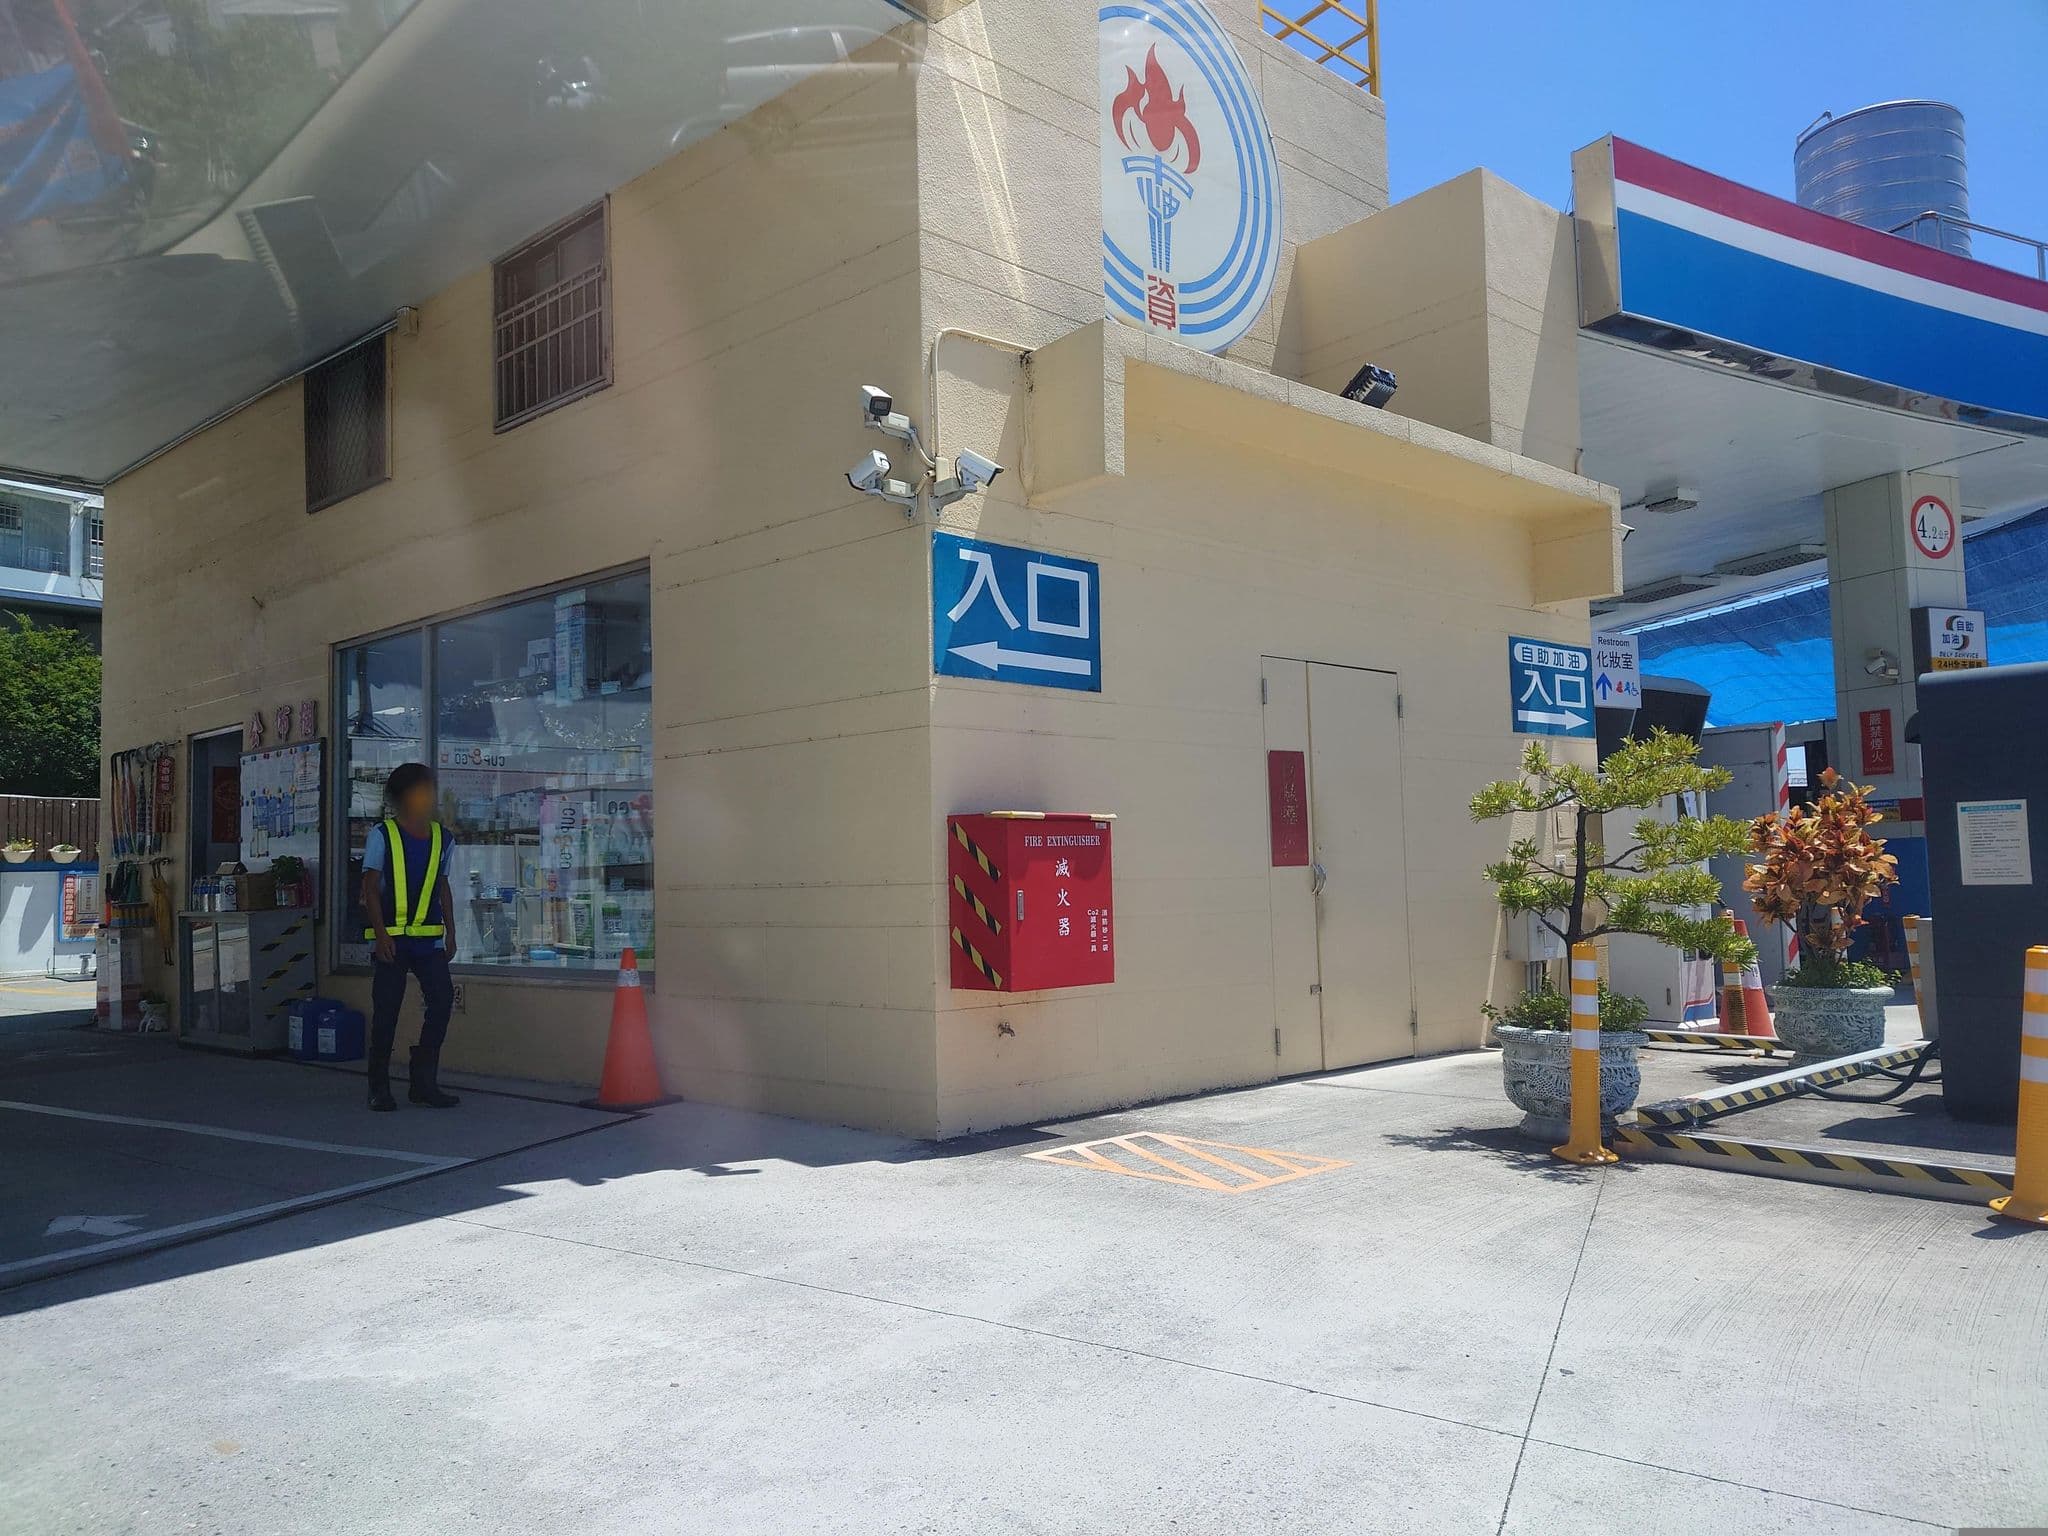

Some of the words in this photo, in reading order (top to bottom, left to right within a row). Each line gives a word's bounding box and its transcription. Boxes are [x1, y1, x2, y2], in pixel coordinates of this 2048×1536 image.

[946, 547, 1090, 640] 入口
[1956, 619, 1975, 633] 自助
[1597, 636, 1630, 648] Restroom
[1942, 633, 1960, 645] 加油
[1521, 645, 1580, 669] 自助加油
[1519, 669, 1587, 709] 入口
[1024, 835, 1043, 847] FIRE
[1047, 835, 1101, 847] EXTINGUISHER
[1055, 857, 1071, 936] 滅火器
